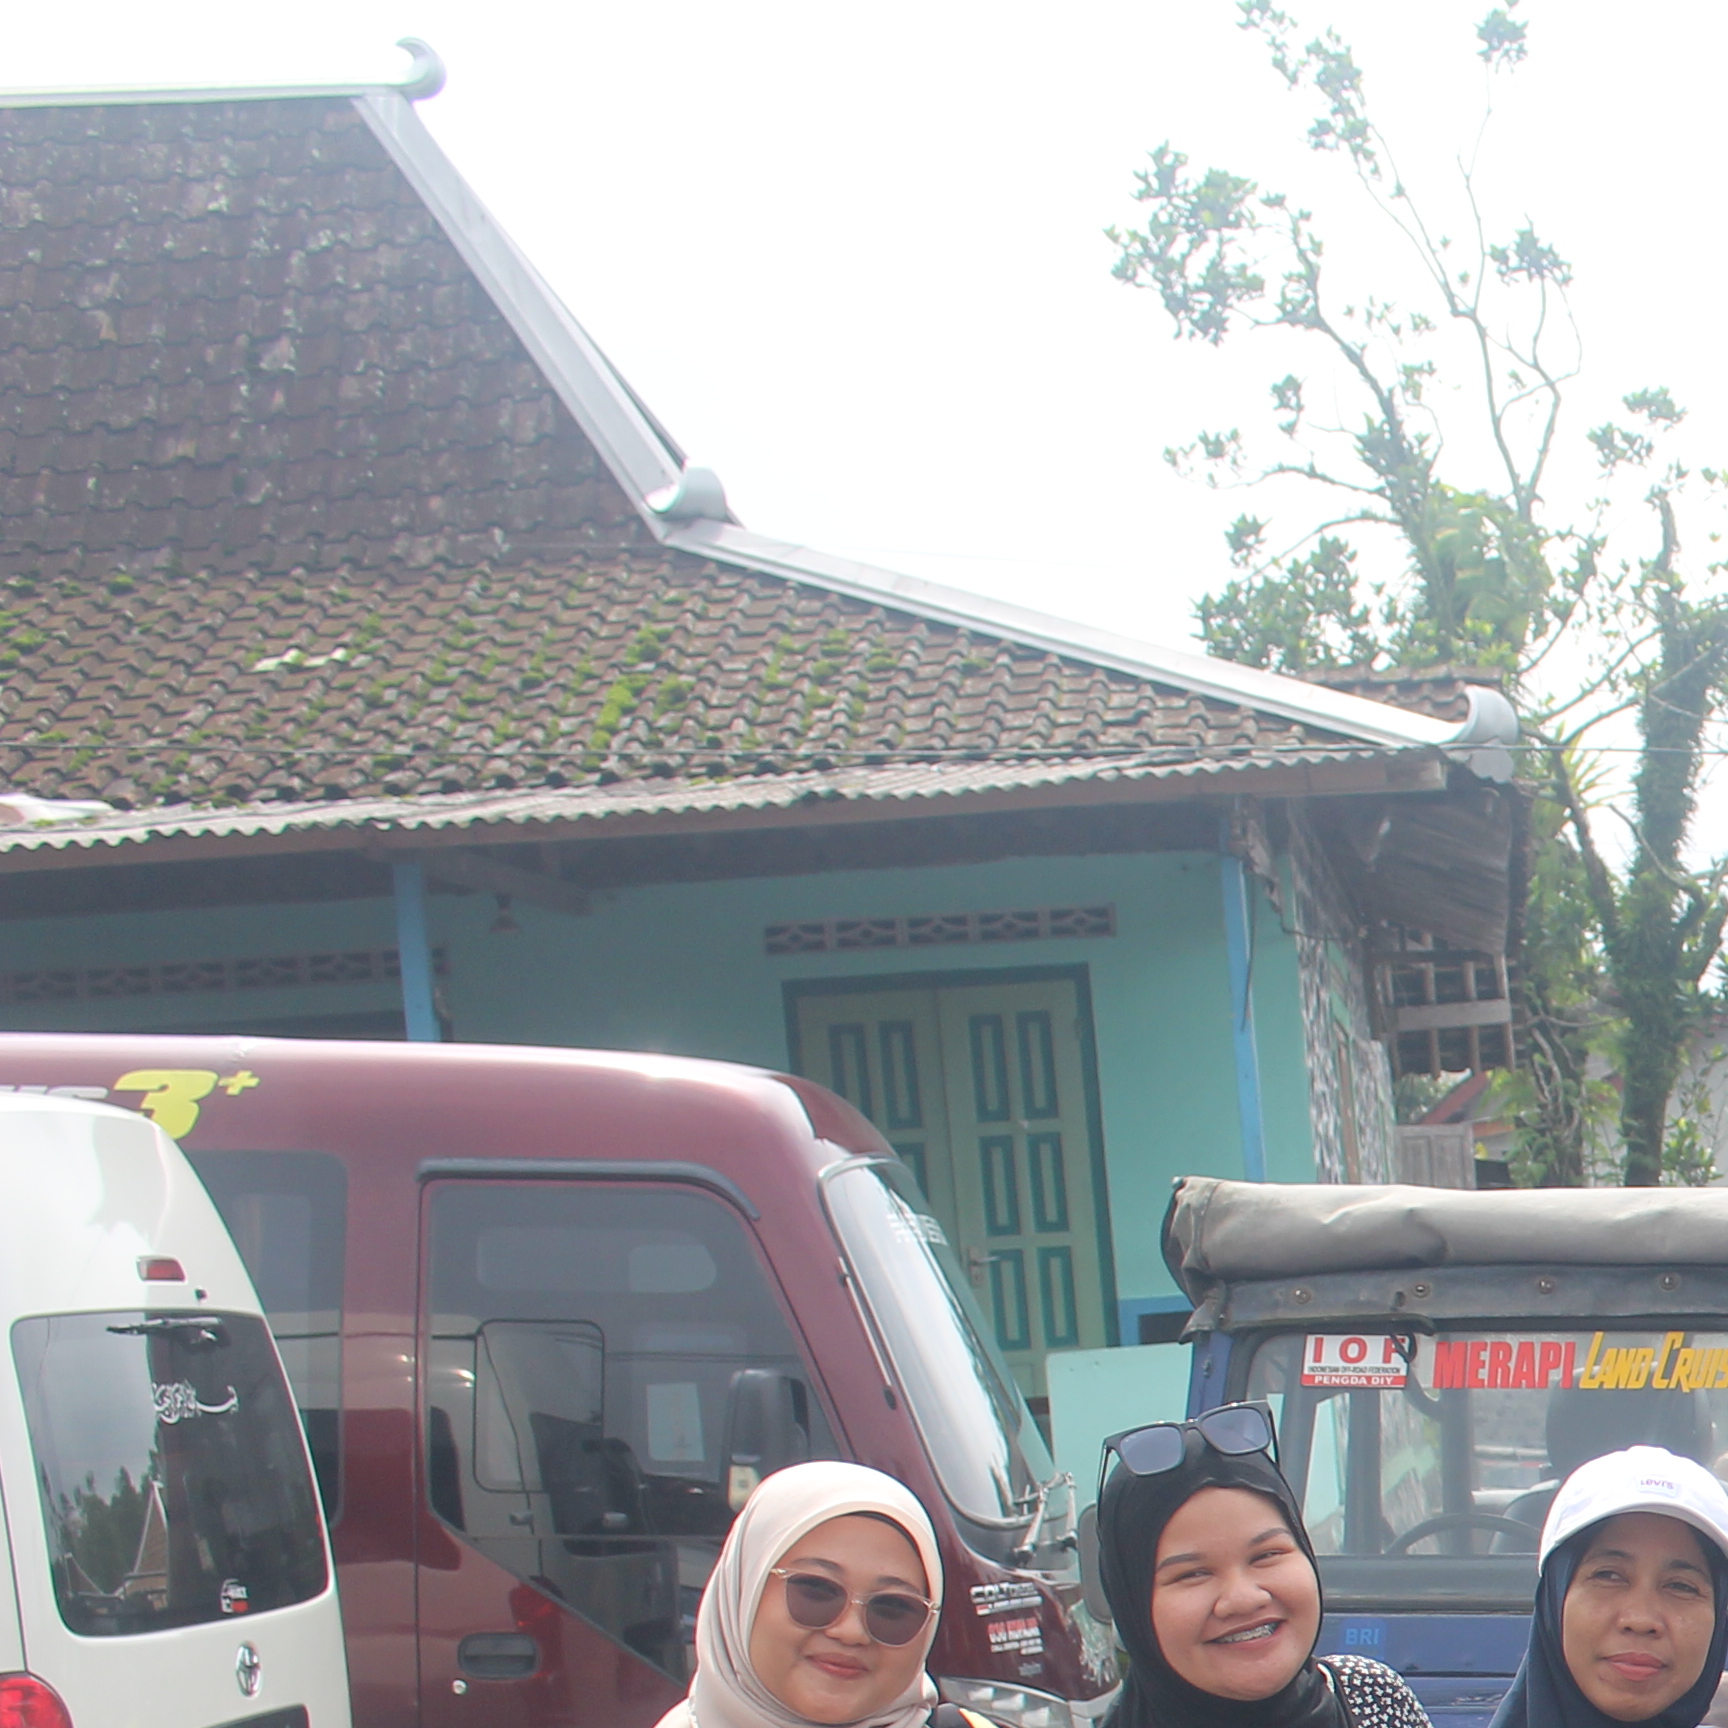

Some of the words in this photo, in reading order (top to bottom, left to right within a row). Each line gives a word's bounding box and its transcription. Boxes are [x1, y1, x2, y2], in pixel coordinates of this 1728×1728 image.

[1432, 1341, 1576, 1389] MERAPI
[1578, 1331, 1655, 1390] LAND
[1314, 1375, 1368, 1385] PENGDA
[1371, 1376, 1394, 1385] DIY
[1345, 1628, 1380, 1645] BRI
